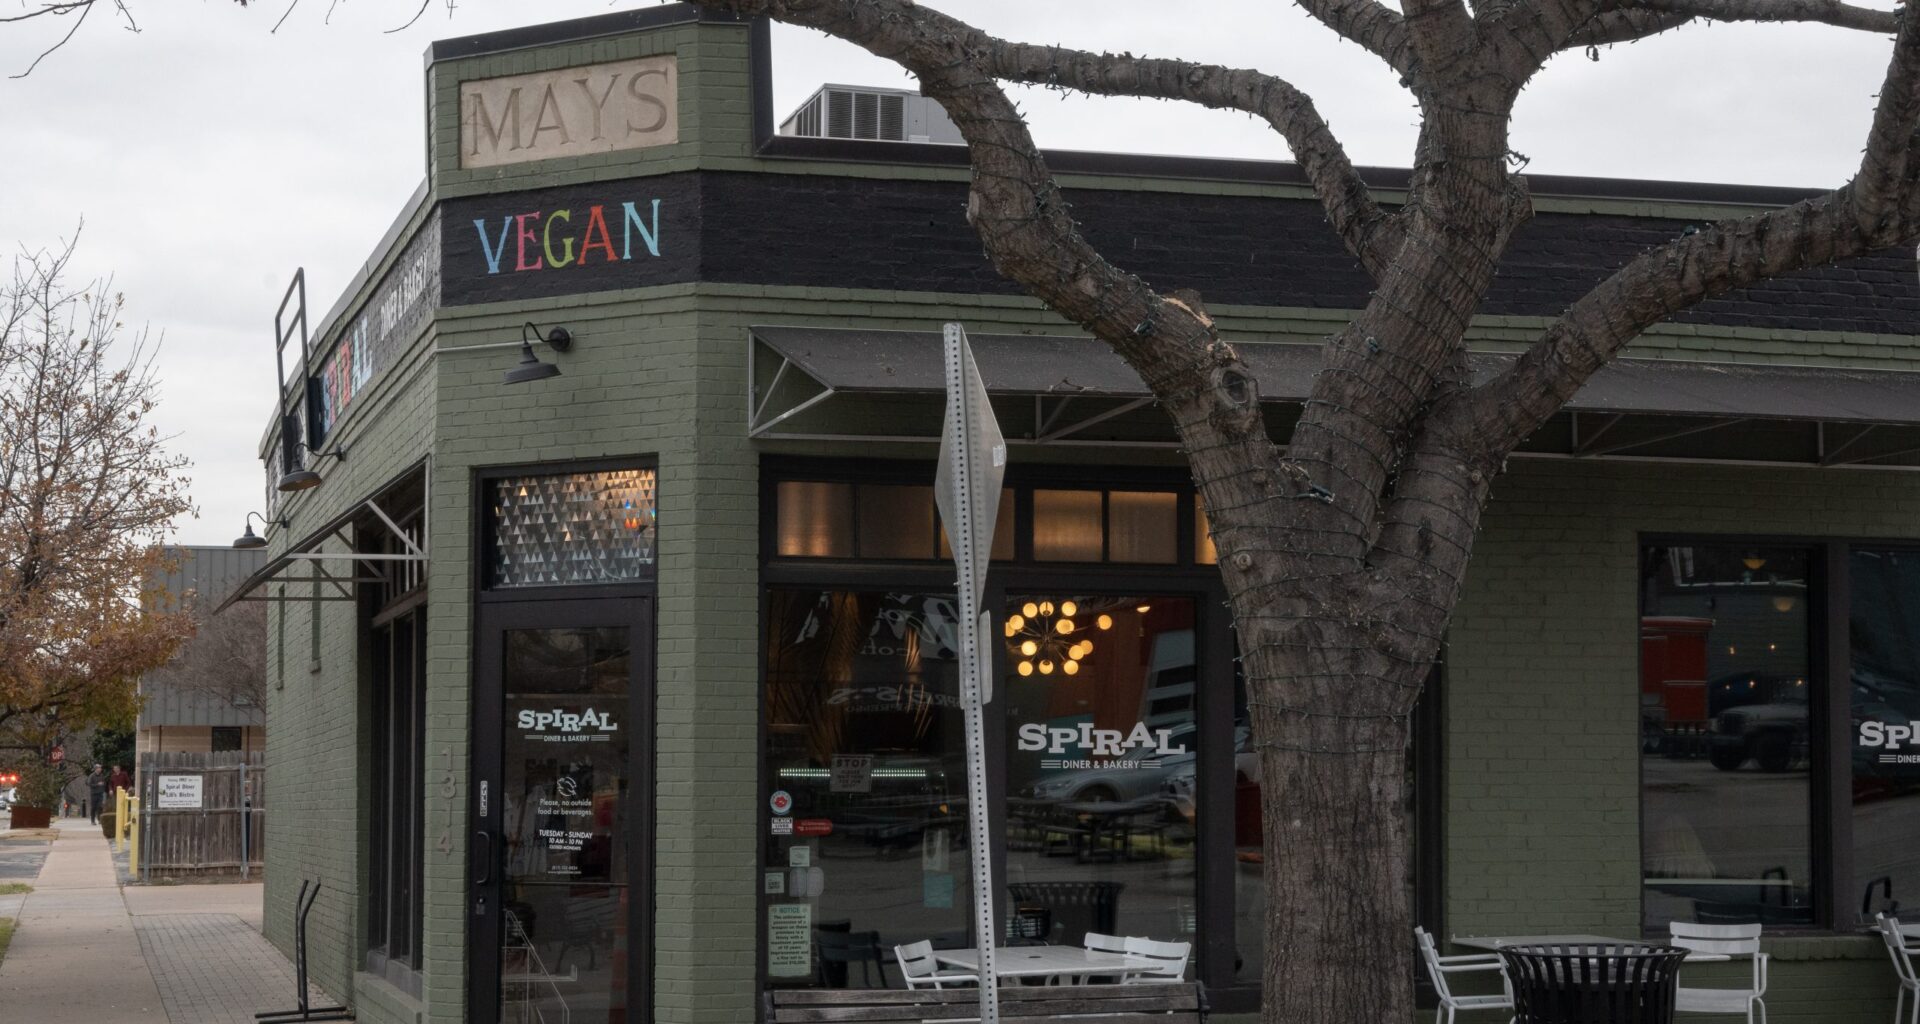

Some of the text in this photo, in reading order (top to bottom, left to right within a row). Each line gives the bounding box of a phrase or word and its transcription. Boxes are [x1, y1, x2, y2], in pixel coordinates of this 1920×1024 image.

[470, 68, 669, 156] MAYS
[473, 199, 661, 274] VEGAN
[517, 707, 618, 732] SPIRAL
[1018, 721, 1186, 756] SPIRAL
[837, 759, 868, 768] STOP
[1062, 760, 1140, 769] DINER & BAKERY
[540, 798, 561, 807] Please,
[538, 807, 552, 815] food
[539, 829, 564, 838] TUESDAY
[568, 831, 593, 839] SUNDAY
